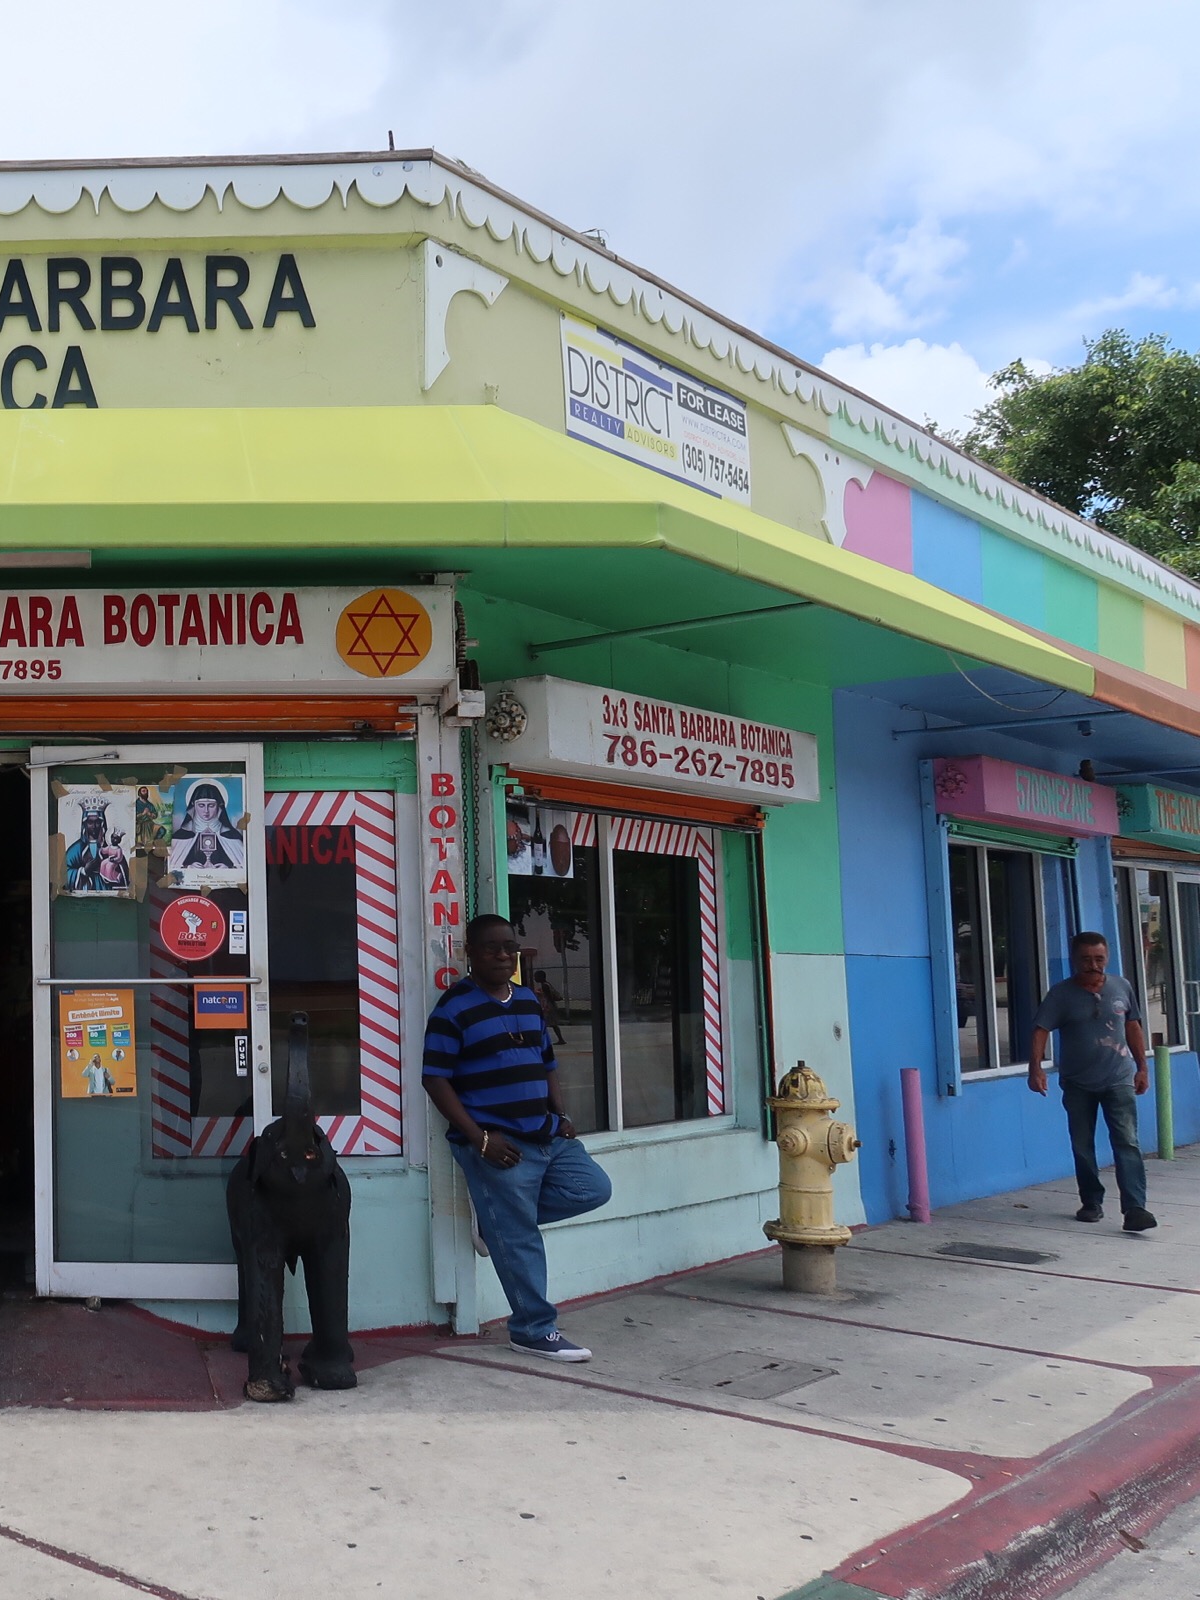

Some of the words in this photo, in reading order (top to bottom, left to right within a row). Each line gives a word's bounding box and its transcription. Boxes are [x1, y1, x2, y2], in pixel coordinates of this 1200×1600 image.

[567, 346, 673, 438] DISTRICT
[680, 388, 705, 413] FOR
[707, 400, 744, 432] LEASE
[574, 402, 621, 434] REALTY
[627, 428, 675, 458] ADVISORS
[681, 442, 707, 481] (305)
[709, 454, 749, 494] 757-5454
[103, 591, 305, 647] BOTANICA
[602, 694, 628, 729] 3x3
[634, 700, 676, 738] SANTA
[680, 710, 737, 748] BARBARA
[740, 723, 794, 759] BOTANICA
[602, 733, 796, 790] 786-262-7895
[1155, 789, 1178, 831] THE
[1178, 796, 1200, 836] COL
[179, 932, 207, 941] BOSS
